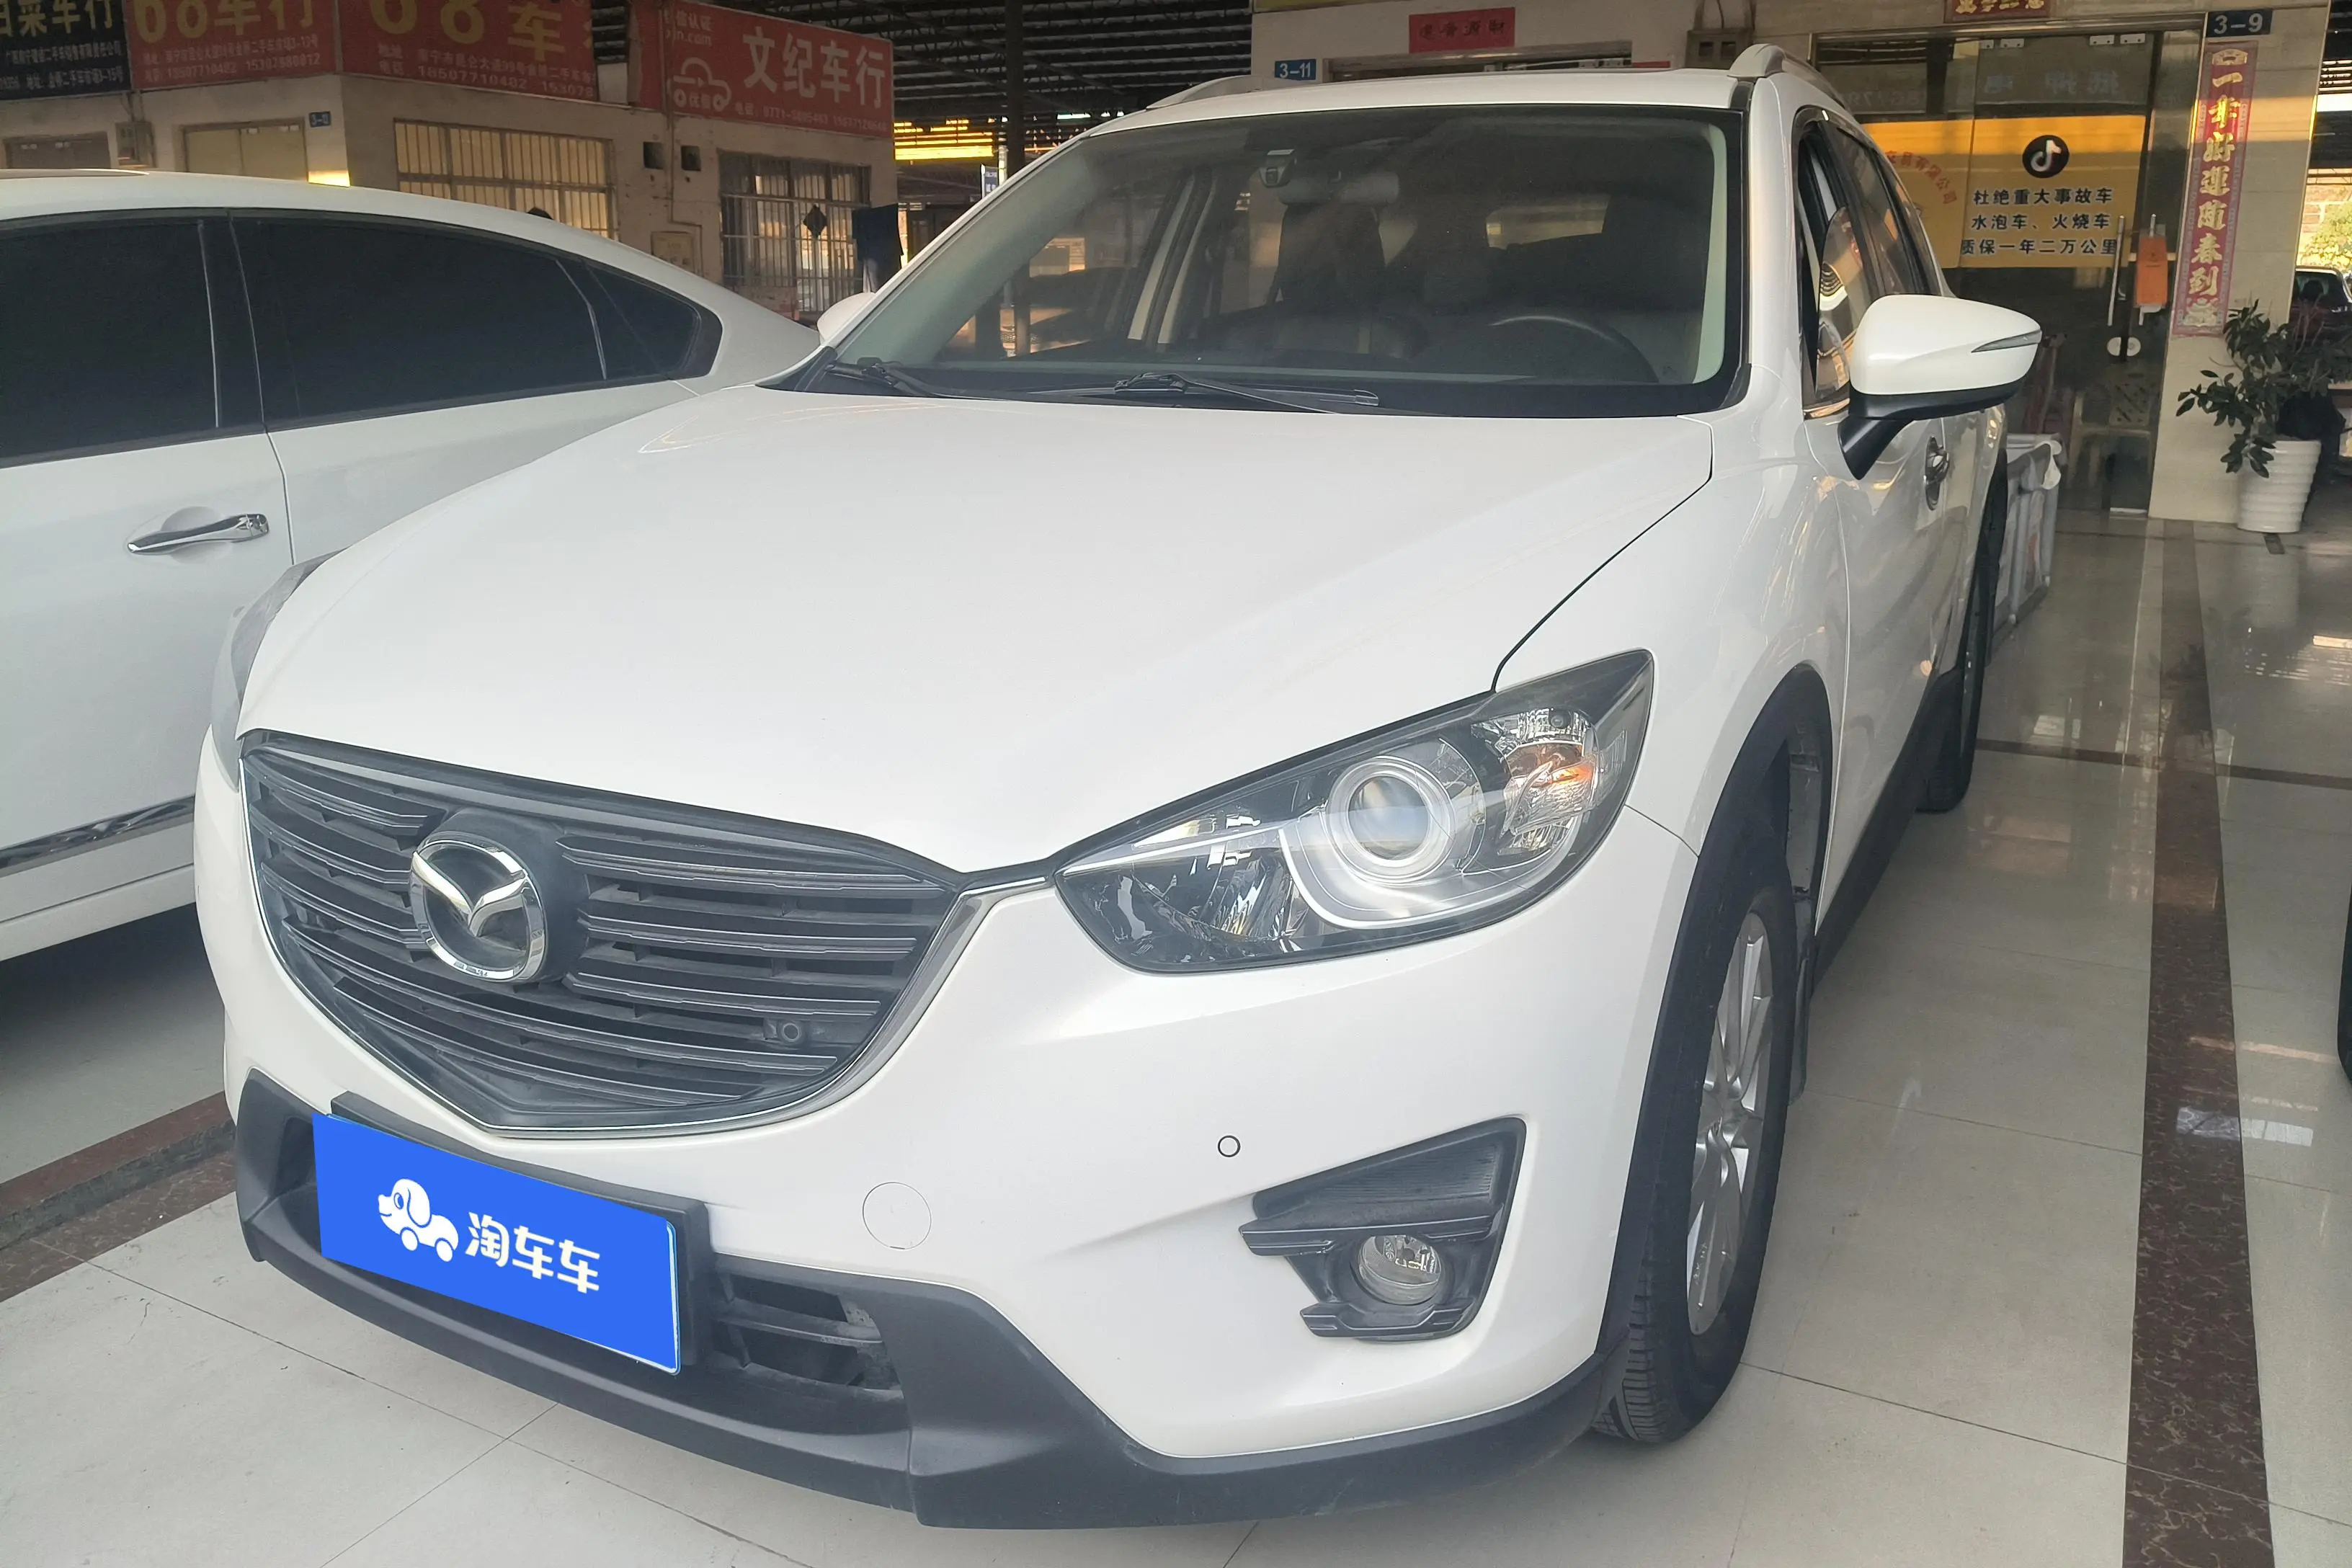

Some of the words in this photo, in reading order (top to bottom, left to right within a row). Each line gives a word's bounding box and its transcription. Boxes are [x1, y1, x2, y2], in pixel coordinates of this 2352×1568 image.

[2214, 12, 2263, 35] 3-9
[742, 26, 886, 110] 文纪车行
[1279, 61, 1311, 79] 3-11
[1972, 187, 2113, 205] 杜绝重大事故车
[1971, 213, 2111, 231] 水泡车、火烧车
[1961, 239, 2118, 255] 质保一年二万公里
